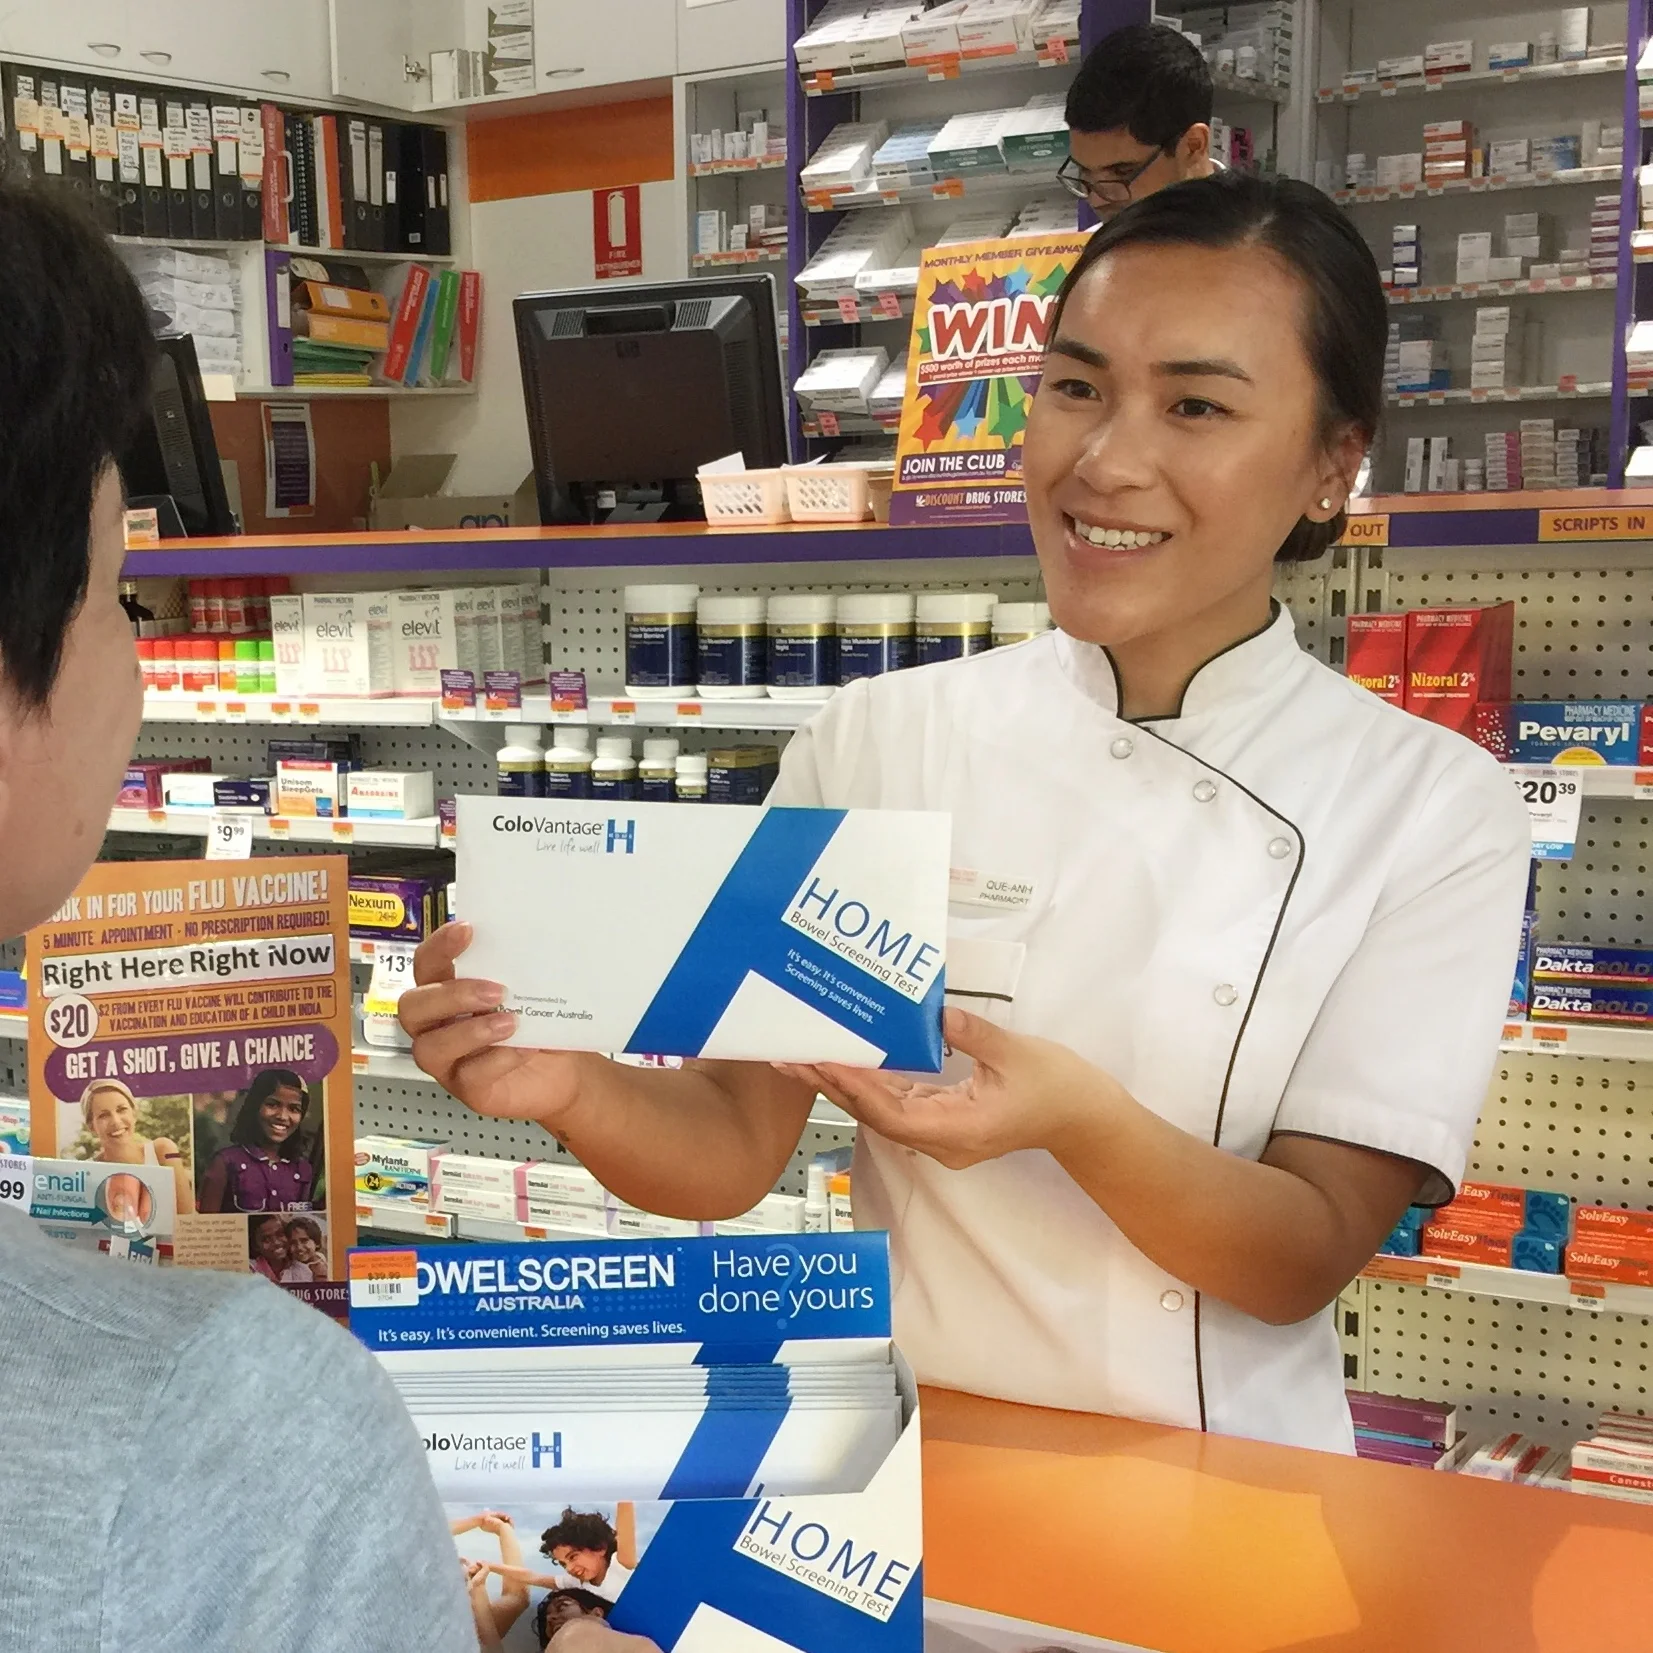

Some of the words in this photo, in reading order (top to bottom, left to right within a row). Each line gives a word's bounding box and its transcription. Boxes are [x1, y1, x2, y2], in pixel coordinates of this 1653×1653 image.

[924, 253, 974, 268] MONTHLY
[975, 248, 1023, 261] MEMBER
[928, 295, 1059, 361] WIN
[920, 363, 939, 375] $500
[940, 360, 963, 371] worth
[964, 359, 974, 369] of
[975, 357, 1001, 369] prizes
[1002, 355, 1027, 366] each
[903, 458, 935, 475] JOIN
[939, 455, 964, 471] THE
[966, 453, 1006, 470] CLUB
[965, 491, 990, 505] DRUG
[1350, 523, 1384, 537] OUT
[1552, 516, 1619, 533] SCRIPTS
[1627, 516, 1646, 531] IN
[274, 620, 300, 632] elevit
[316, 621, 354, 638] elevit
[401, 619, 440, 636] elevit
[1411, 672, 1458, 687] Nizoral
[1565, 705, 1602, 717] PHARMACY
[1603, 705, 1636, 717] MEDICINE
[1519, 721, 1629, 746] Pevaryl
[492, 815, 602, 836] ColoVantage
[536, 838, 557, 852] Live
[560, 837, 576, 856] life
[579, 842, 602, 854] well
[87, 895, 104, 919] IN
[107, 892, 138, 917] FOR
[141, 888, 184, 915] YOUR
[188, 878, 226, 911] FLU
[232, 869, 329, 908] VACCINE!
[986, 880, 1034, 894] QUE-ANH
[349, 894, 396, 910] Nexium
[43, 935, 51, 950] 5
[53, 930, 95, 949] MINUTE
[101, 923, 174, 945] APPOINTMENT
[184, 921, 199, 938] NO
[201, 914, 275, 936] PRESCRIPTION
[276, 910, 331, 930] REQUIRED!
[797, 877, 941, 983] HOME
[790, 911, 832, 942] Bowel
[829, 934, 893, 983] Screening
[894, 972, 920, 997] Test
[43, 963, 113, 990] Right
[121, 956, 185, 980] Here
[189, 947, 261, 975] Right
[267, 943, 331, 967] Now
[787, 948, 801, 963] It's
[800, 957, 822, 977] easy.
[822, 970, 836, 984] It's
[836, 977, 887, 1016] convenient.
[98, 1003, 110, 1017] $2
[111, 1000, 136, 1016] FROM
[137, 999, 164, 1015] EVERY
[166, 998, 183, 1012] FLU
[185, 996, 222, 1011] VACCINE
[223, 993, 246, 1008] WILL
[247, 989, 300, 1006] CONTRIBUTE
[302, 987, 315, 1001] TO
[316, 985, 333, 999] THE
[785, 963, 829, 997] Screening
[827, 988, 853, 1011] saves
[852, 1003, 875, 1025] lives.
[50, 1002, 91, 1040] $20
[109, 1014, 168, 1032] VACCINATION
[170, 1012, 188, 1027] AND
[189, 1008, 238, 1025] EDUCATION
[239, 1008, 250, 1021] OF
[252, 1007, 260, 1020] A
[261, 1004, 286, 1019] CHILD
[287, 1004, 297, 1017] IN
[298, 1001, 322, 1017] INDIA
[525, 1006, 555, 1018] Cancer
[555, 1009, 593, 1020] Australia
[65, 1051, 100, 1080] GET
[104, 1048, 119, 1077] A
[123, 1044, 177, 1074] SHOT,
[180, 1040, 221, 1071] GIVE
[226, 1040, 241, 1068] A
[244, 1033, 316, 1065] CHANCE
[372, 1154, 409, 1167] Mylanta
[34, 1171, 85, 1193] enail
[1457, 1185, 1491, 1200] vEasy
[52, 1207, 90, 1219] Infections
[835, 1208, 852, 1219] Derm
[1578, 1208, 1629, 1225] SolvEasy
[1426, 1226, 1478, 1246] SolvEasy
[713, 1249, 791, 1279] Have
[799, 1251, 858, 1284] you
[1570, 1251, 1620, 1269] SolvEasy
[417, 1254, 675, 1297] OWELSCREEN
[288, 1289, 311, 1301] RUG
[475, 1294, 585, 1313] AUSTRALIA
[698, 1283, 781, 1314] done
[789, 1285, 875, 1319] yours
[378, 1327, 398, 1342] It's
[400, 1329, 434, 1344] easy.
[436, 1326, 456, 1341] It's
[458, 1325, 539, 1340] convenient.
[541, 1322, 610, 1339] Screening
[612, 1323, 650, 1336] saves
[652, 1320, 687, 1335] lives.
[423, 1432, 527, 1451] oloVantage
[455, 1457, 477, 1471] Live
[481, 1453, 499, 1473] life
[502, 1455, 526, 1471] well
[1609, 1474, 1653, 1489] Canest
[748, 1499, 911, 1602] HOME
[739, 1534, 787, 1567] Bowel
[786, 1557, 859, 1603] Screening
[862, 1591, 891, 1617] Test
